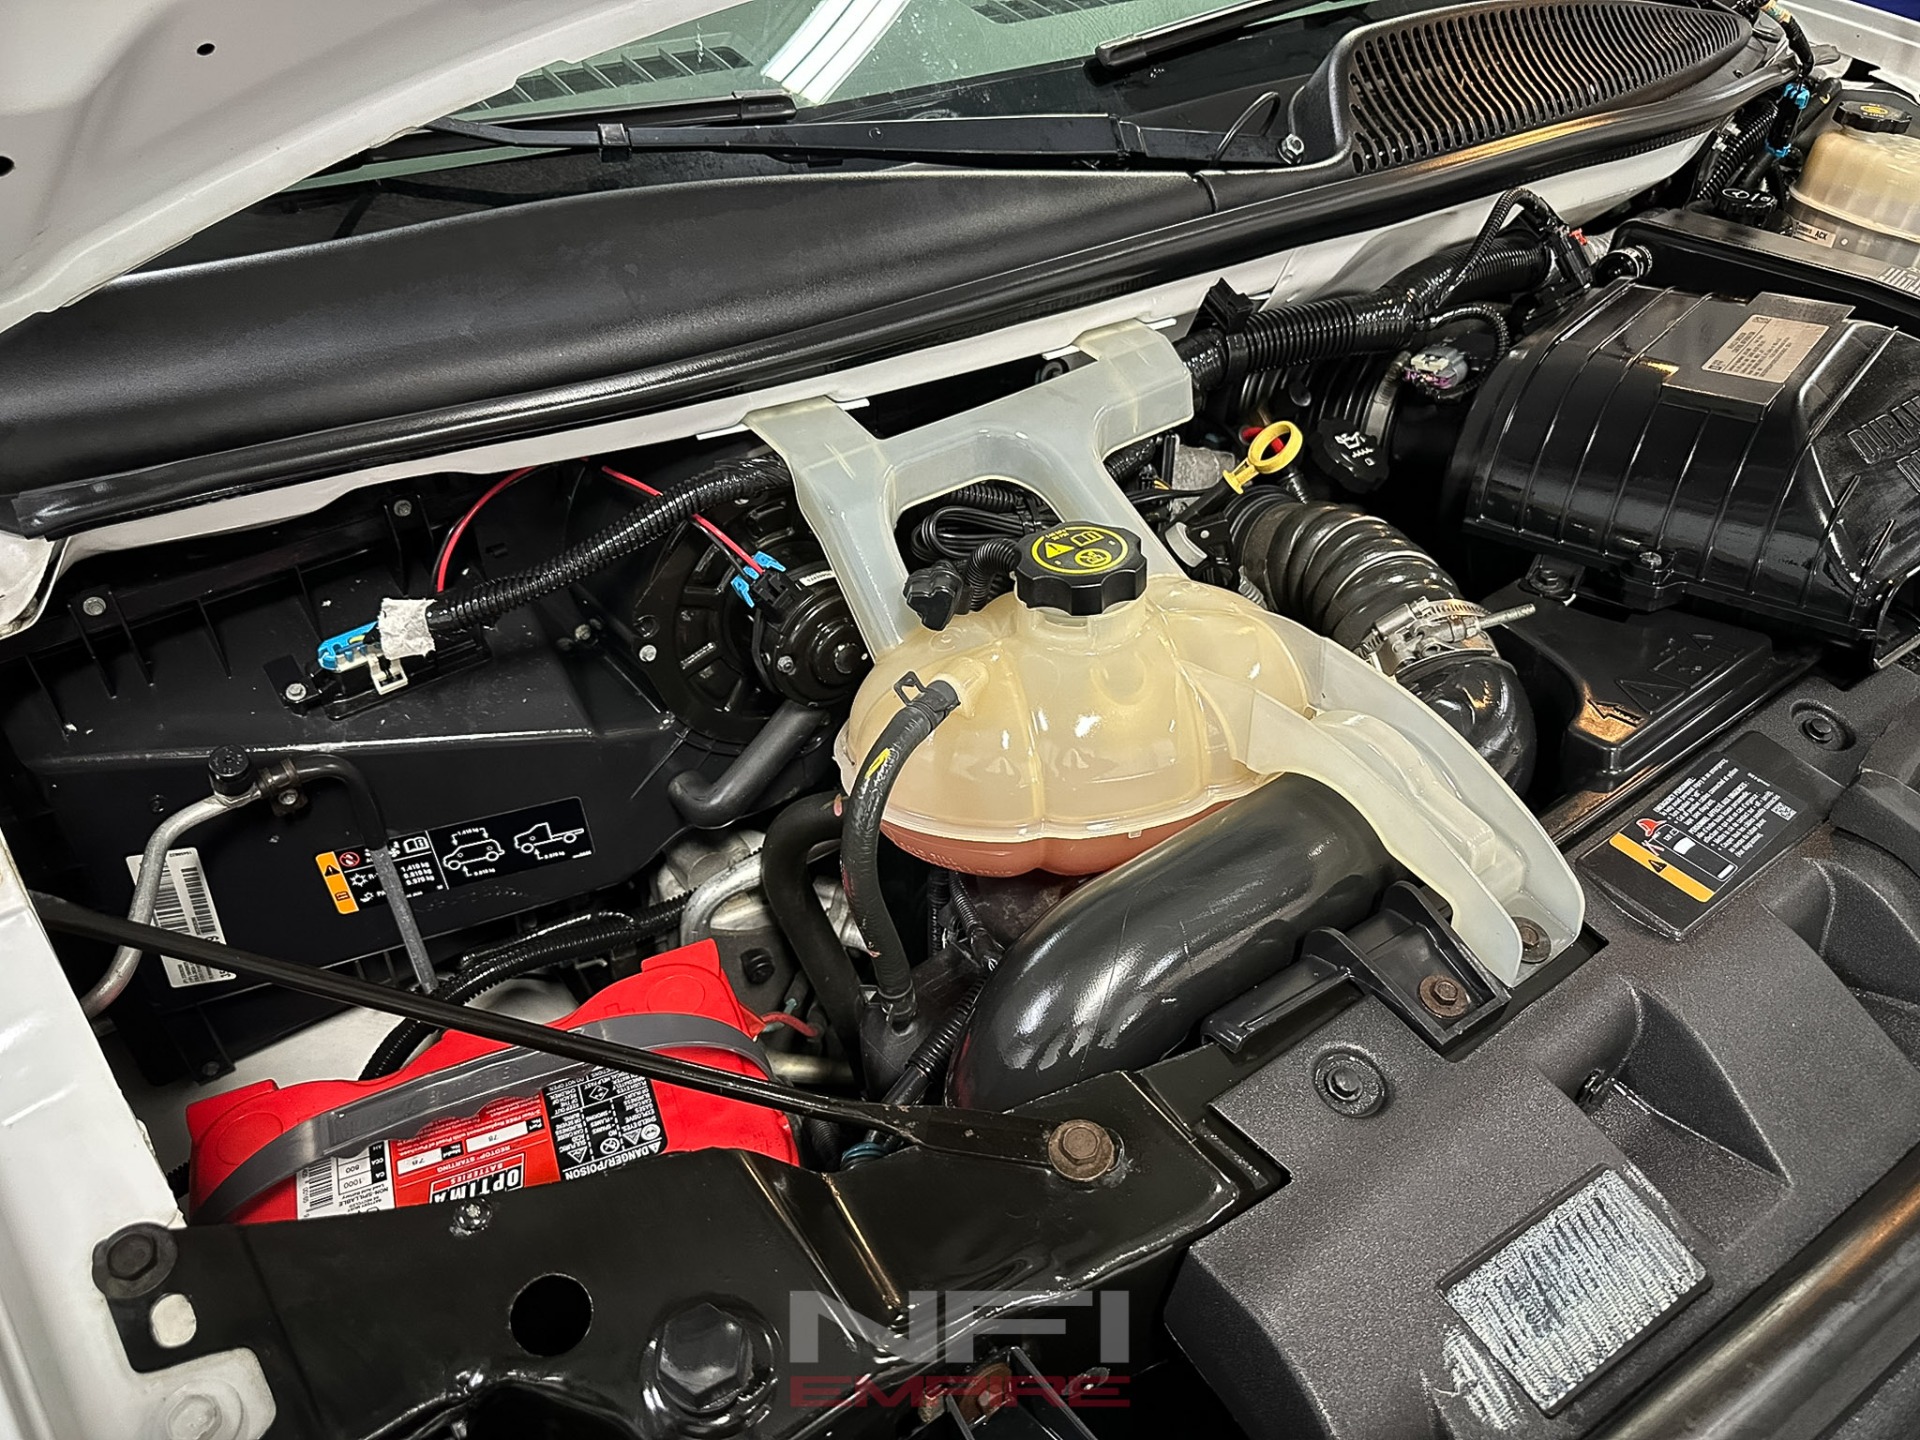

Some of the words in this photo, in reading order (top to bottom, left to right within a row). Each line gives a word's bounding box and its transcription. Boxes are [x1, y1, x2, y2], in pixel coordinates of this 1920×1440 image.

[597, 1076, 610, 1084] HELP
[633, 1102, 653, 1113] GASES
[585, 1109, 608, 1121] SMOKING
[623, 1108, 655, 1123] EXPLOSIVE
[589, 1116, 610, 1127] FLAMES
[466, 1119, 503, 1136] Replacement
[591, 1123, 611, 1134] SPARKS
[607, 1128, 617, 1136] NO
[436, 1136, 452, 1145] Proof
[452, 1132, 466, 1140] with
[571, 1133, 585, 1142] ACID
[370, 1157, 384, 1165] CCA
[436, 1155, 475, 1173] STARTING
[564, 1144, 649, 1180] DANGER/POISON
[449, 1162, 503, 1184] BATTERIES
[342, 1177, 362, 1188] 1000
[432, 1167, 523, 1204] OPTIMA
[337, 1186, 389, 1206] NON-SPILLABLE
